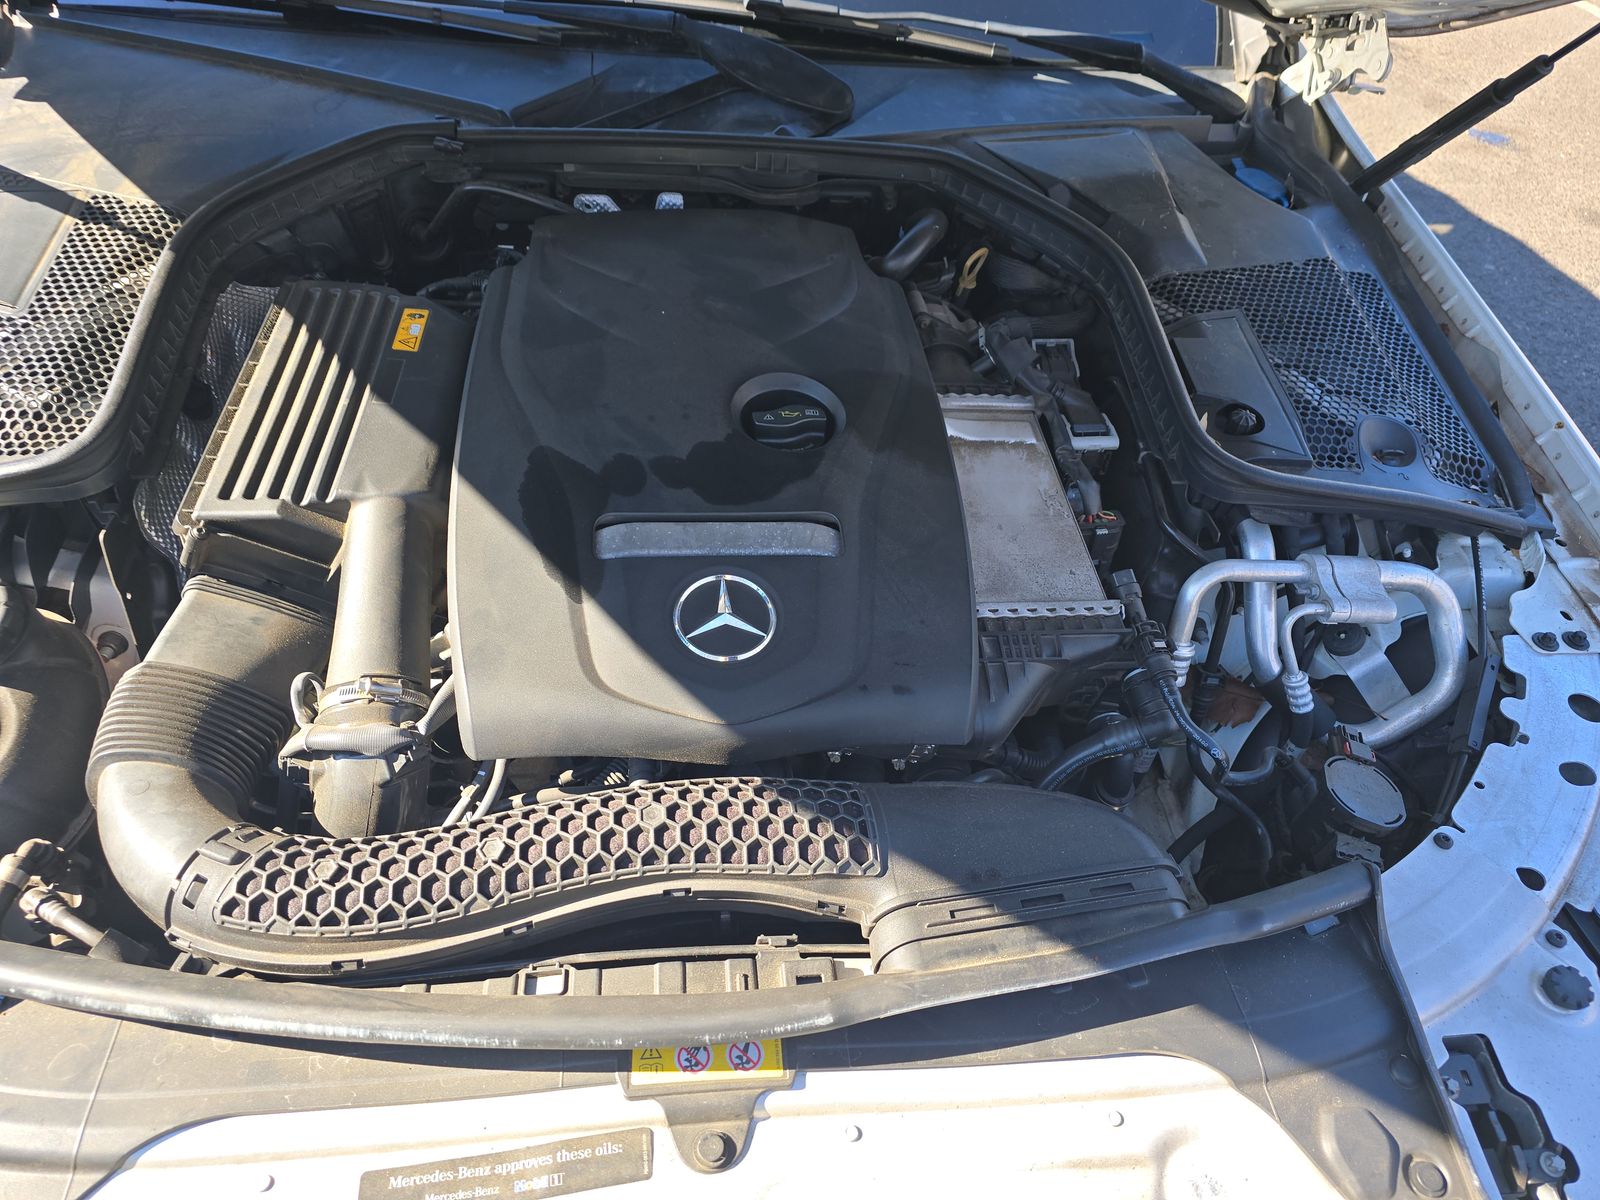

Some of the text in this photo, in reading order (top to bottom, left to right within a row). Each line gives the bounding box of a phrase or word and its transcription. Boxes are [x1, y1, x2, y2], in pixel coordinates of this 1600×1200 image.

[388, 1165, 491, 1189] Mercedes-Benz
[494, 1153, 554, 1176] approves
[555, 1148, 592, 1163] these
[595, 1141, 624, 1157] oils:
